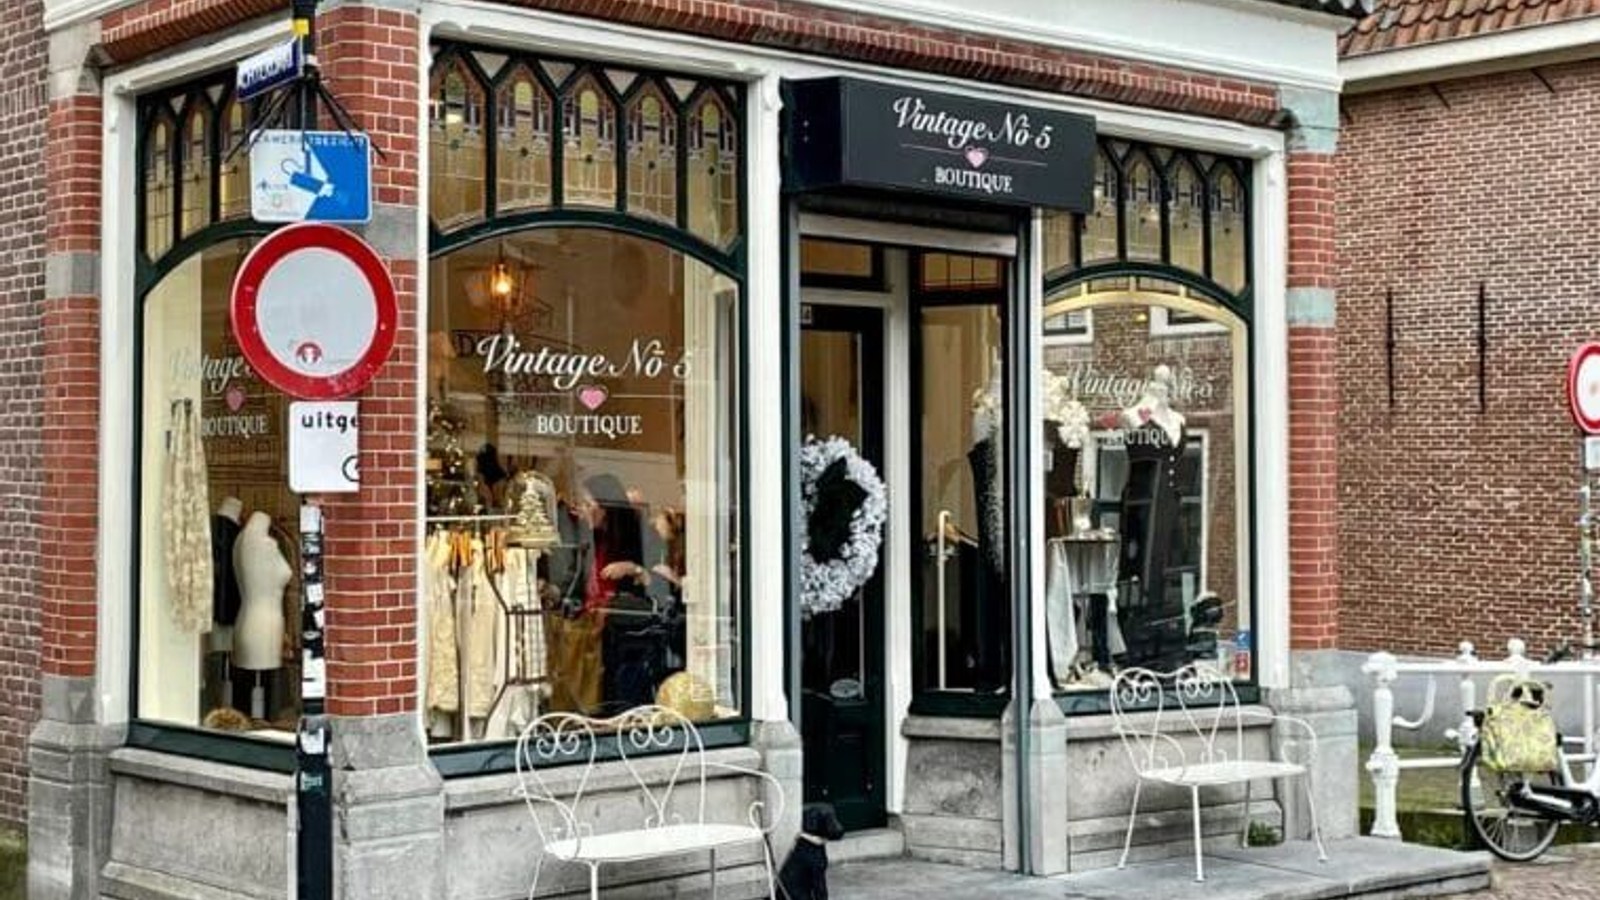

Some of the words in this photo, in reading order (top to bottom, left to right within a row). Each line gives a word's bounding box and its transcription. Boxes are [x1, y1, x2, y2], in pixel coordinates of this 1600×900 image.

[893, 96, 986, 148] Vintage
[1035, 125, 1054, 149] 5
[935, 166, 1013, 194] BOUTIQUE
[170, 347, 244, 394] Vtage
[477, 333, 606, 390] Vintage
[673, 351, 694, 379] 5
[535, 414, 644, 439] BOUTIQUE
